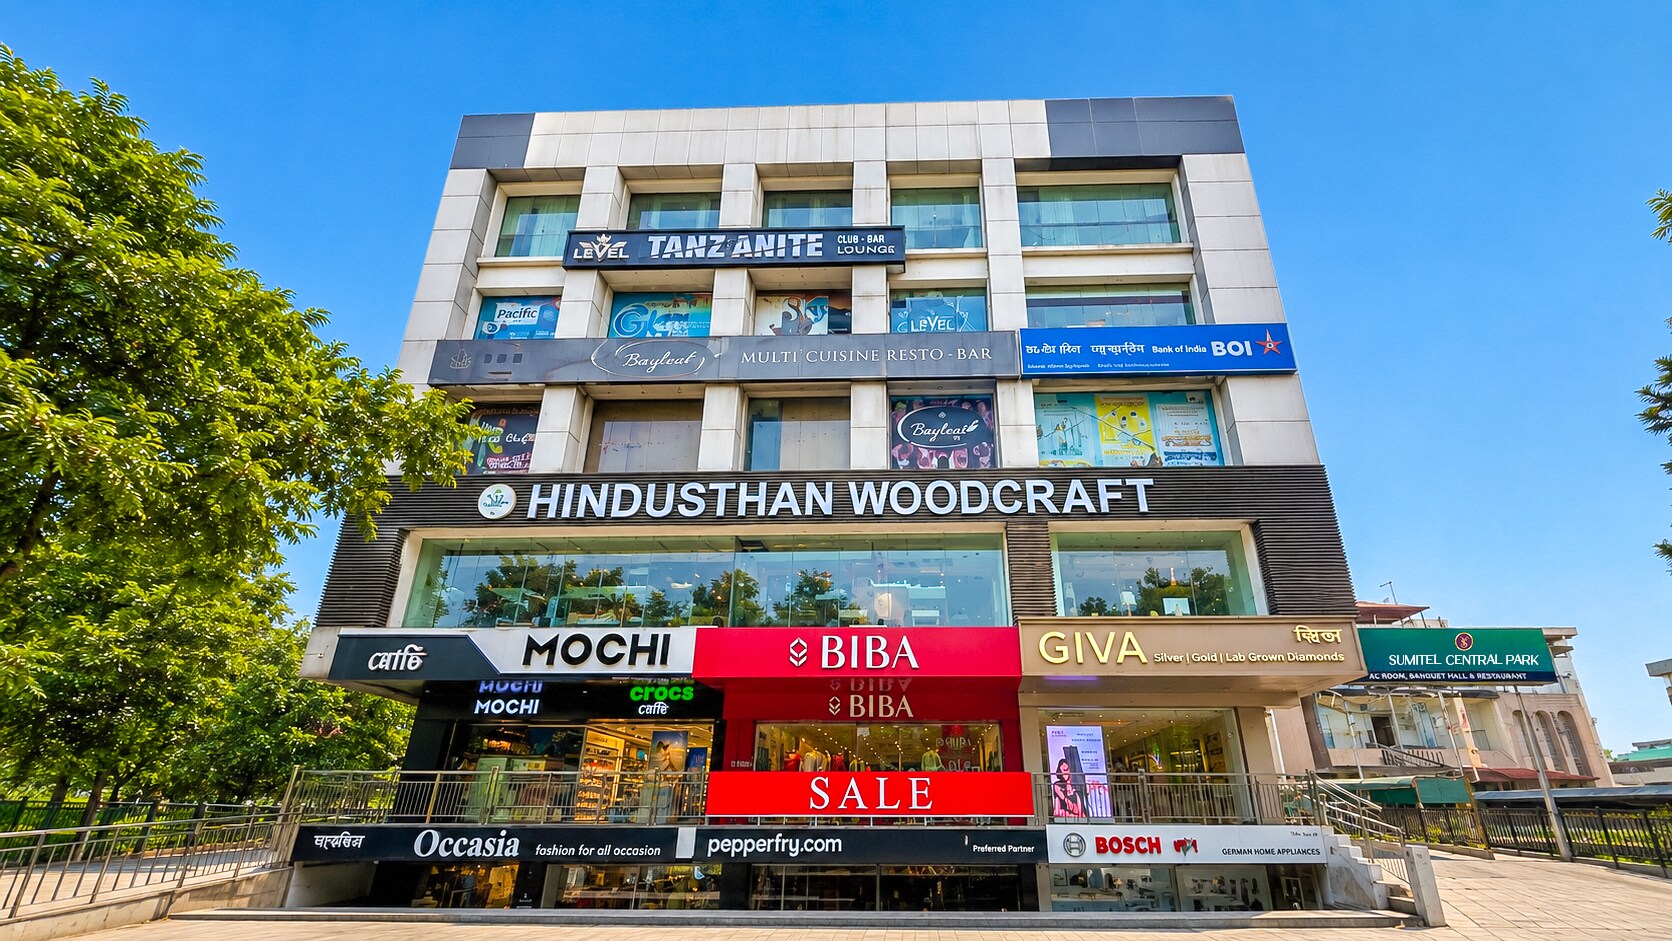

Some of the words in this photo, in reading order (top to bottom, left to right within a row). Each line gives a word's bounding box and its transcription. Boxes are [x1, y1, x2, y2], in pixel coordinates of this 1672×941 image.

[837, 234, 859, 244] CLUB
[866, 234, 885, 244] BAR
[573, 241, 630, 262] LEVEL
[837, 245, 895, 255] LOUNGE
[497, 307, 538, 319] Pacific
[805, 350, 880, 363] CUISINE
[886, 348, 944, 361] RESTO
[957, 347, 992, 360] BAR
[1152, 345, 1174, 354] Bank
[1175, 344, 1183, 353] of
[1185, 344, 1207, 353] India
[1211, 340, 1253, 357] BOI
[526, 481, 833, 519] HINDUSTHAN
[848, 477, 1154, 516] WOODCRAFT
[522, 632, 672, 667] MOCHI
[821, 635, 920, 669] BIBA
[1038, 631, 1149, 665] GIVA
[1153, 652, 1184, 663] Silver
[1191, 652, 1218, 663] Gold
[1226, 652, 1246, 663] Lab
[1248, 652, 1285, 662] Grown
[1286, 651, 1345, 662] Diamonds
[1389, 654, 1442, 666] SUMITEL
[1445, 653, 1503, 665] CENTRAL
[1505, 654, 1539, 666] PARK
[1369, 672, 1380, 680] AC
[630, 685, 695, 702] crocs
[473, 699, 539, 715] MOCHI
[850, 694, 914, 718] BIBA
[809, 776, 933, 811] SALE
[413, 829, 520, 858] Occasia
[535, 843, 575, 856] fashion
[578, 843, 595, 856] for
[597, 843, 612, 856] all
[613, 844, 661, 856] occasion
[707, 833, 843, 857] pepperfry.com
[972, 844, 1006, 853] Preferred
[1007, 844, 1035, 853] Partner
[1095, 836, 1162, 854] BOSCH
[1222, 848, 1253, 856] GERMAN
[1254, 848, 1276, 856] HOME
